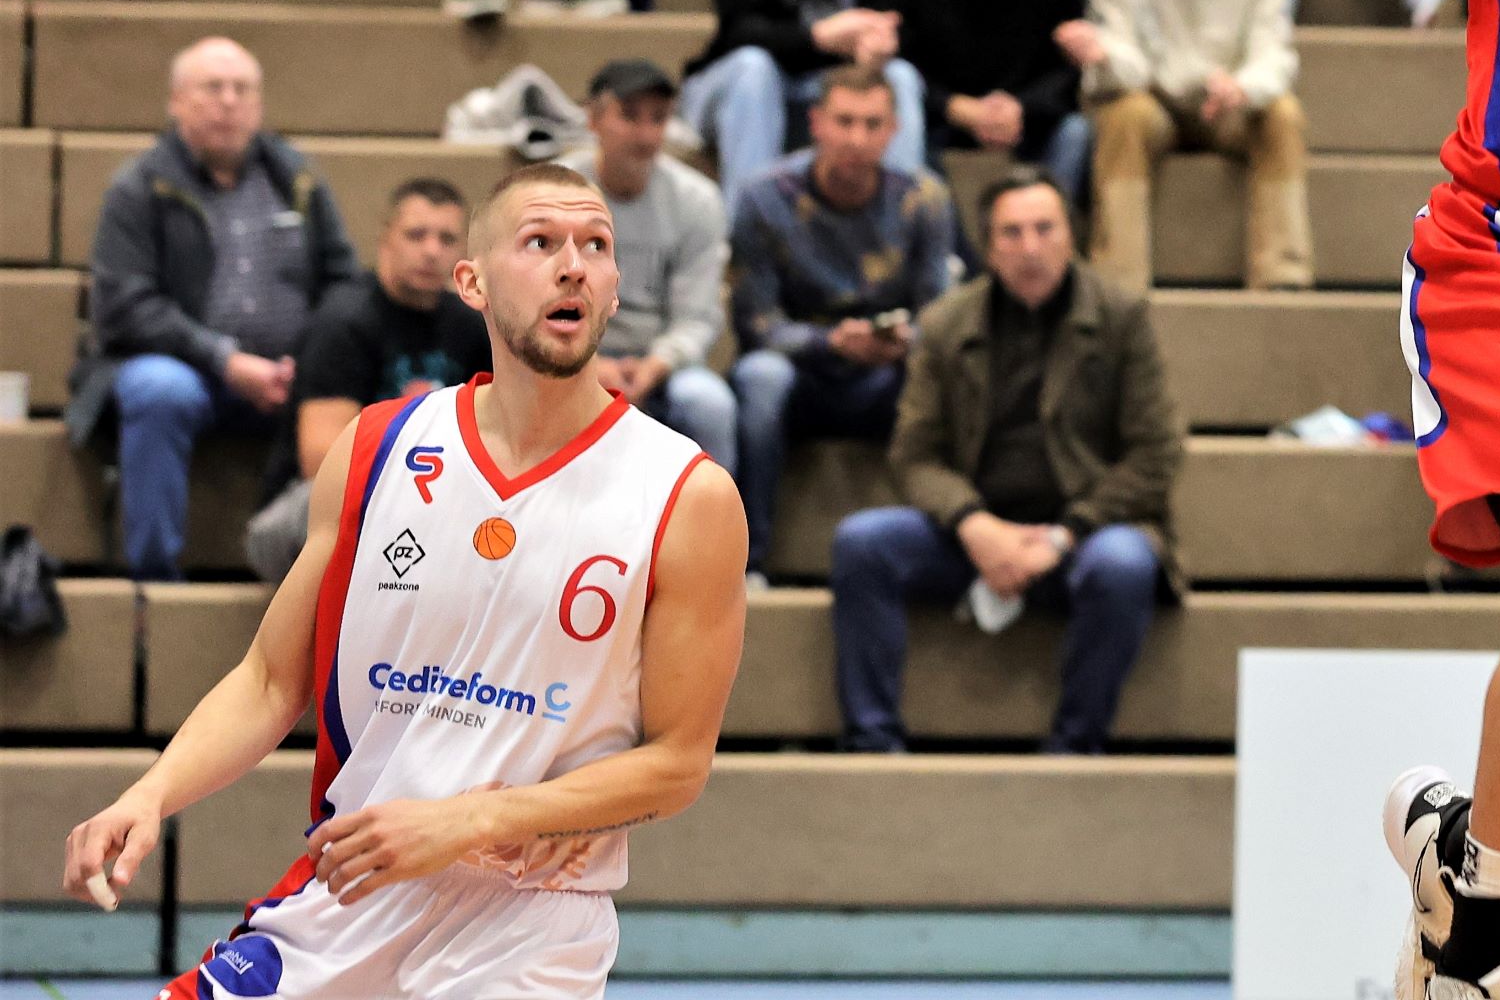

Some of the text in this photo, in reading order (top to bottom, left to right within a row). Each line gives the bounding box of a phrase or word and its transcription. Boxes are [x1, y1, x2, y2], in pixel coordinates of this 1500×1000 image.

[378, 581, 420, 592] peakzone
[558, 554, 629, 642] 6
[422, 703, 486, 729] MINDEN
